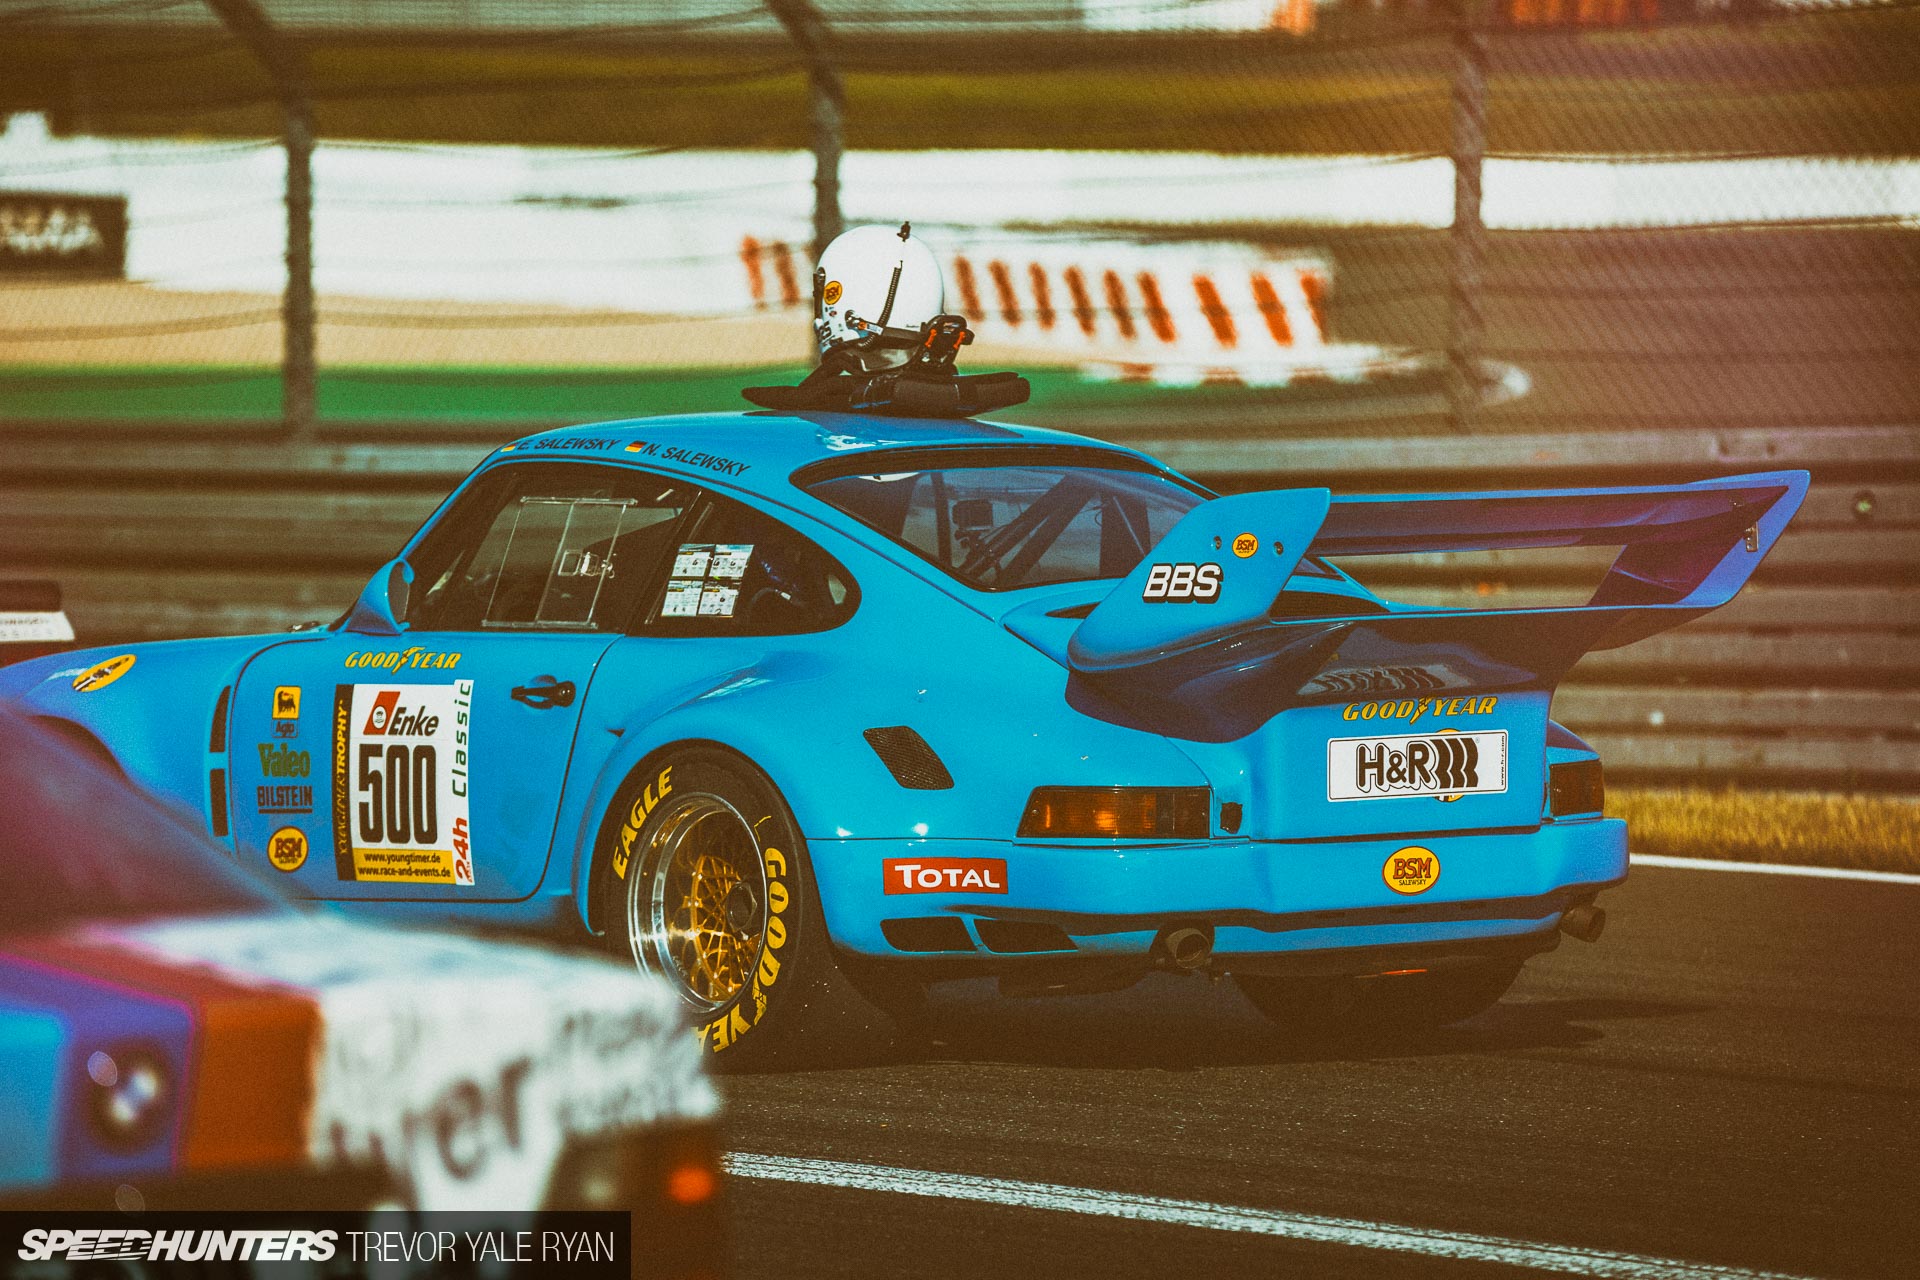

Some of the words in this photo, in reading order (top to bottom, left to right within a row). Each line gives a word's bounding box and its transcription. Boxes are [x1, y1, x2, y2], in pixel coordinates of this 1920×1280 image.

[518, 440, 529, 451] E.
[534, 438, 621, 451] SALEWSKY
[642, 443, 657, 457] N.
[661, 446, 751, 477] SALEWSKY
[1236, 539, 1255, 550] BSM
[1143, 562, 1224, 603] BBS
[345, 647, 461, 675] GOODYEAR
[387, 705, 439, 737] Enke
[1343, 697, 1498, 724] GOODYEAR
[452, 682, 471, 798] Classic
[257, 742, 311, 778] Valeo
[1356, 740, 1438, 793] H&R
[257, 785, 313, 807] BILSTEIN
[359, 744, 438, 844] 500
[612, 765, 673, 880] EAGLE
[274, 837, 303, 859] BSM
[364, 853, 441, 866] www.youngtimer.de
[452, 817, 471, 883] 24h
[357, 866, 451, 879] www.race-and-events.de
[1393, 858, 1432, 879] BSM
